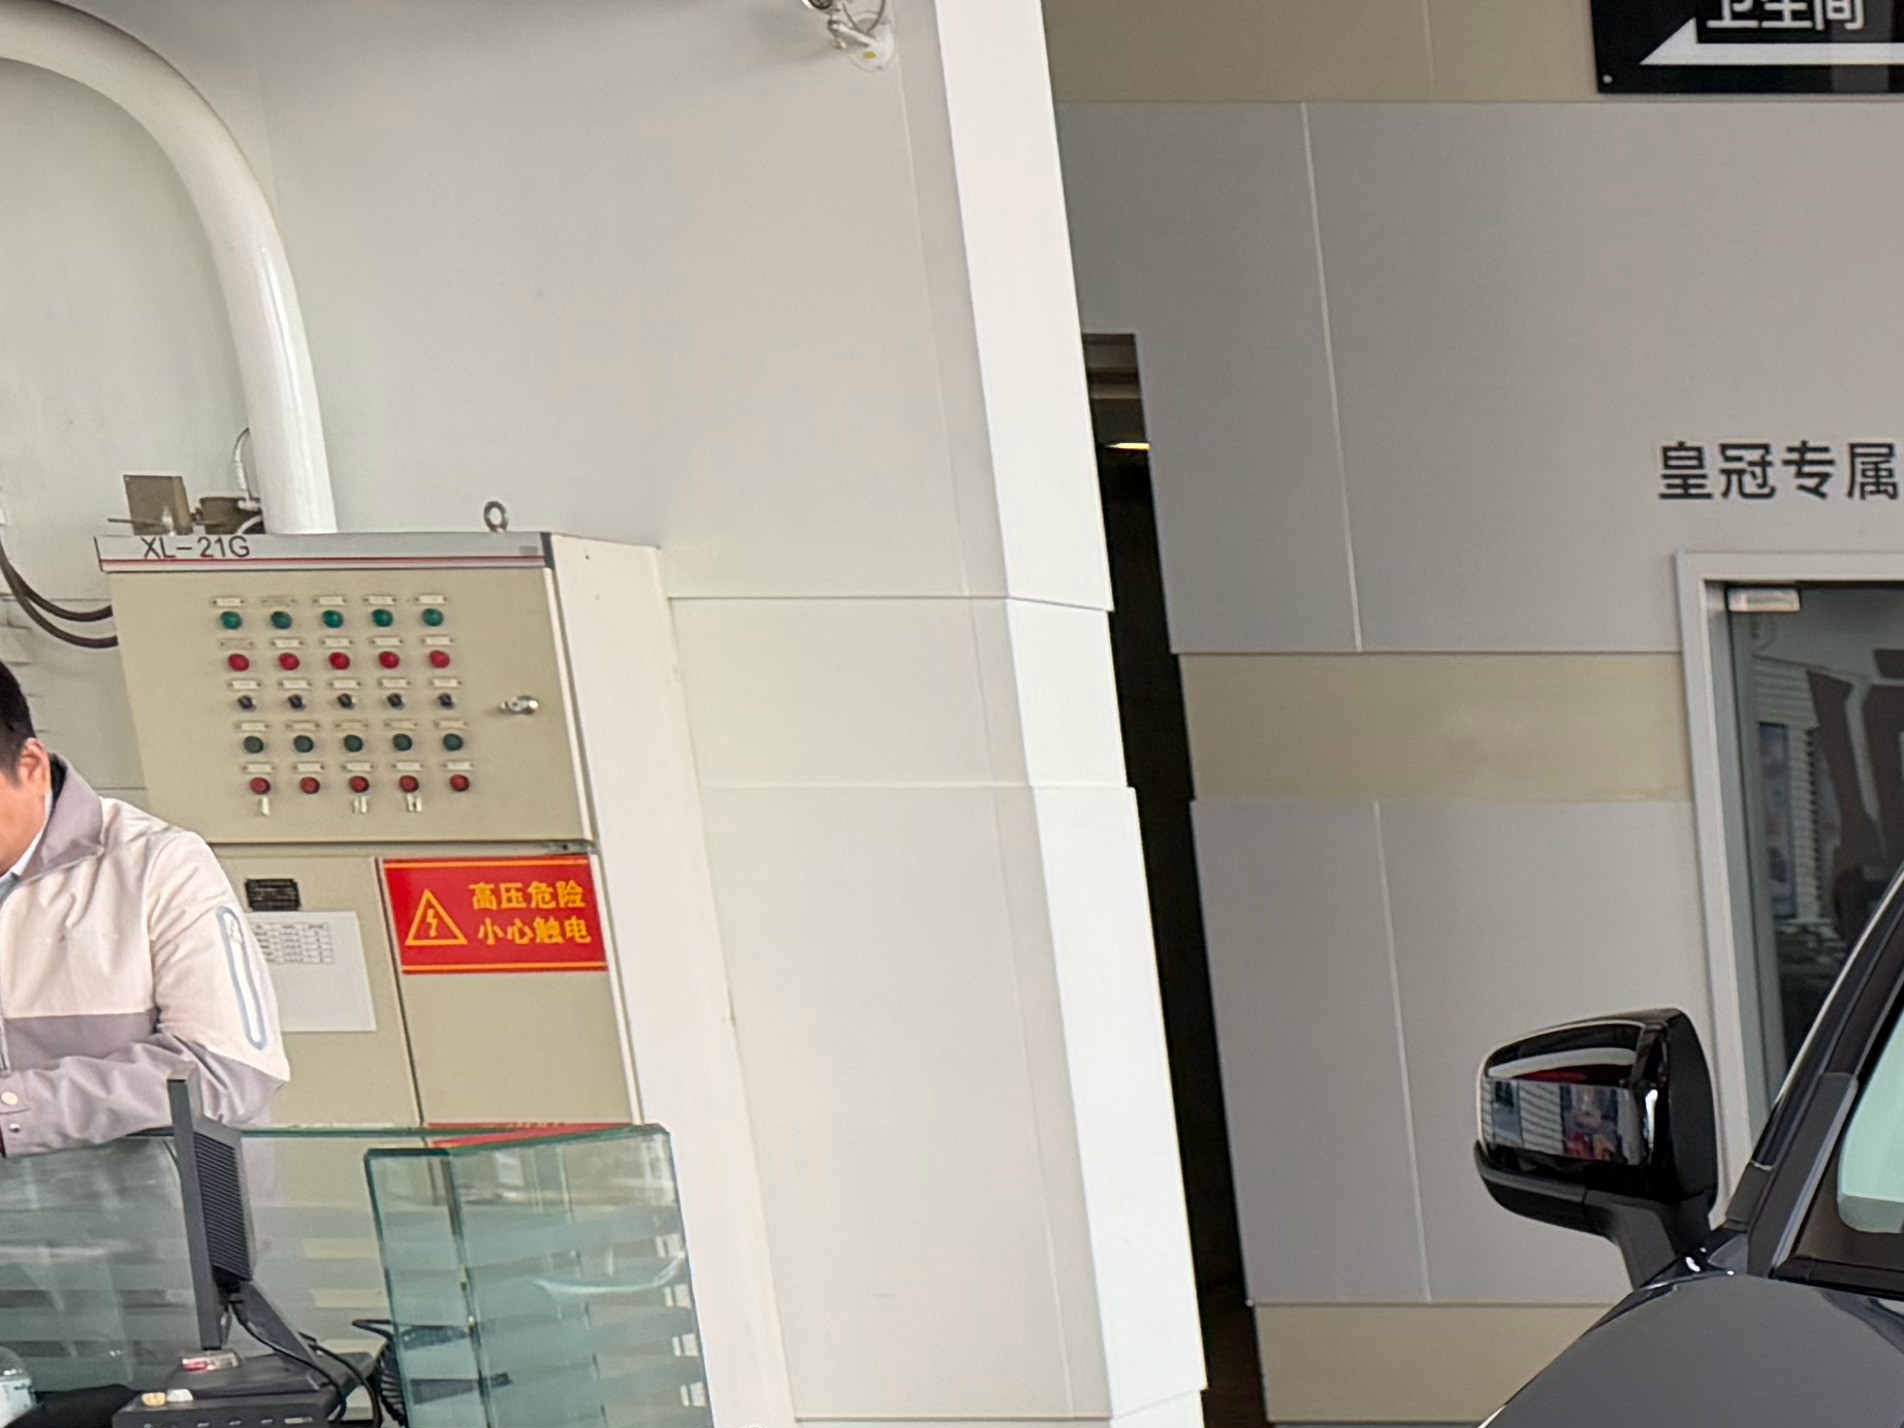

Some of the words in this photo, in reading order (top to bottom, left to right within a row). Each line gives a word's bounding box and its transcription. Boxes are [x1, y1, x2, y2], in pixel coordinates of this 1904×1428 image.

[142, 535, 251, 559] XL-21G
[469, 880, 586, 911] 高压危险
[477, 916, 592, 946] 小心触电
